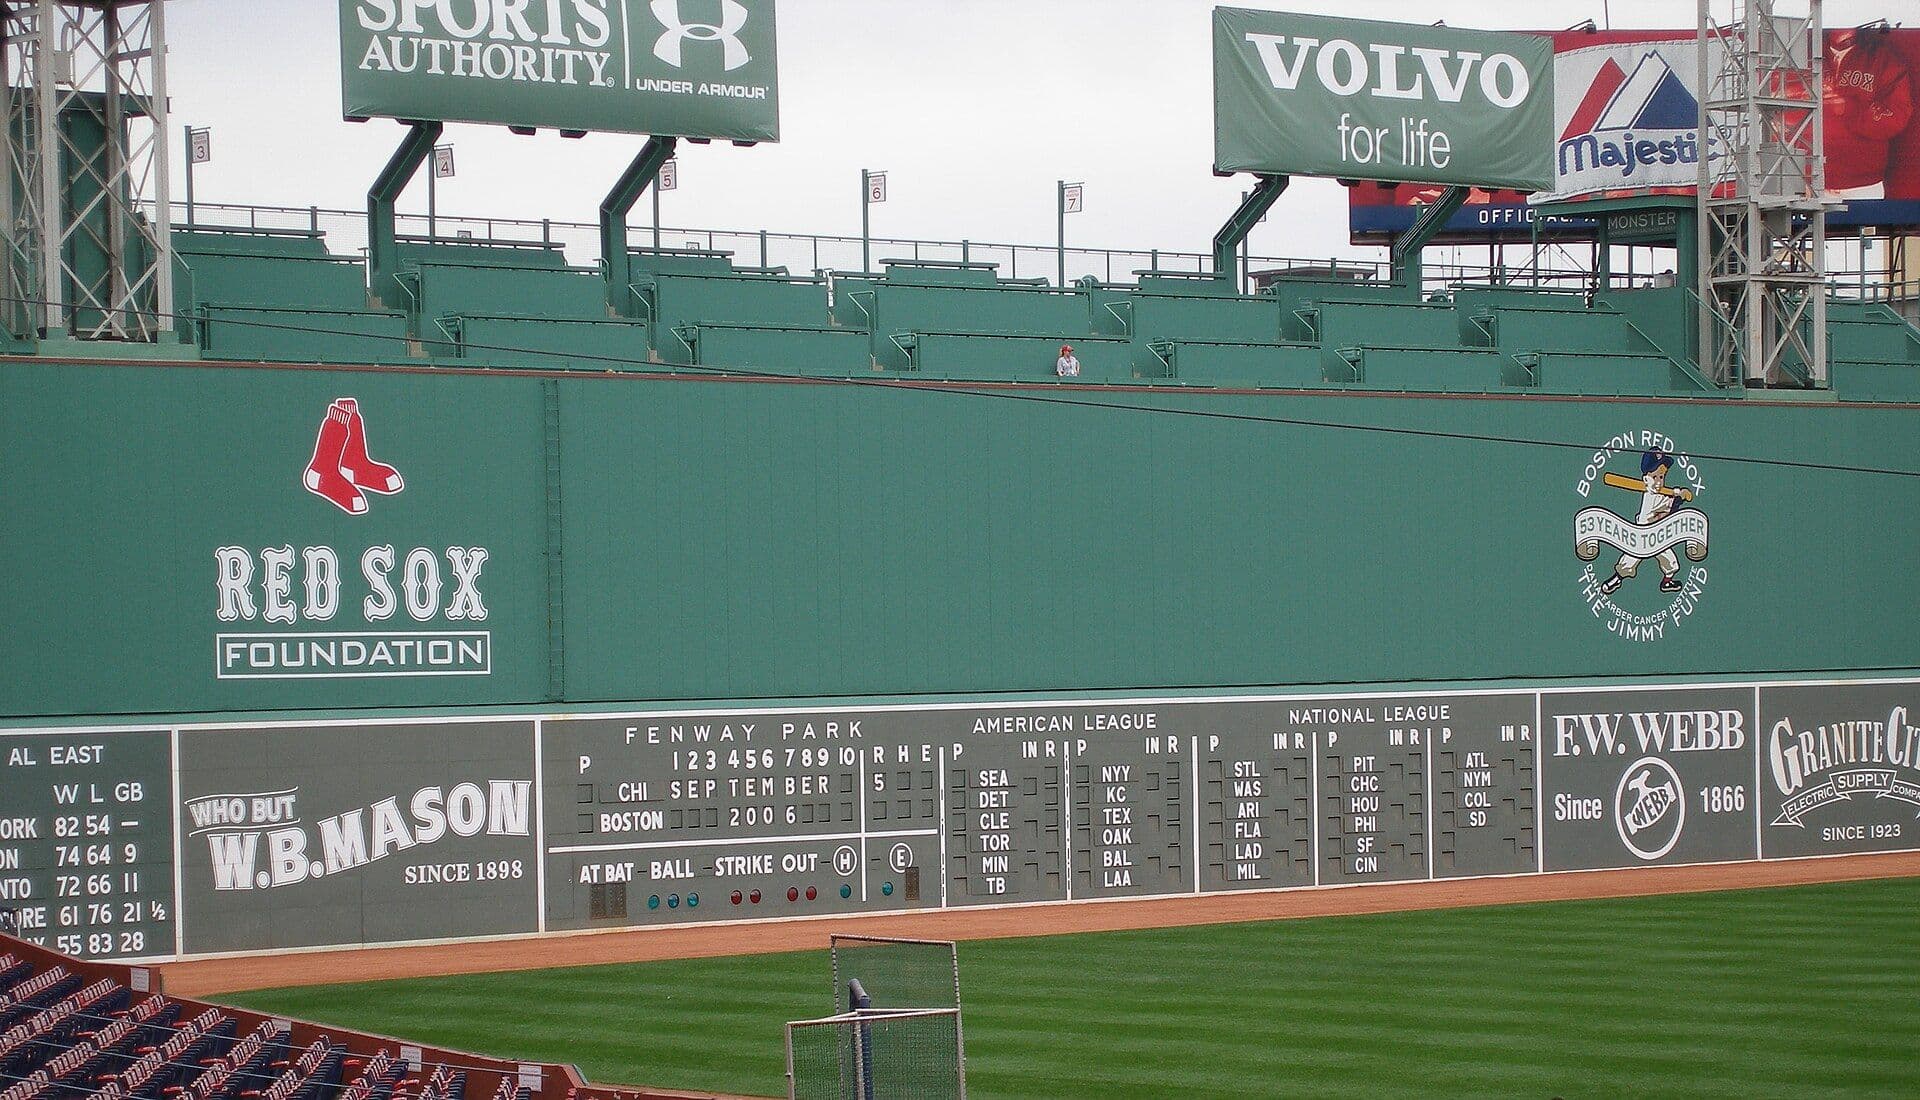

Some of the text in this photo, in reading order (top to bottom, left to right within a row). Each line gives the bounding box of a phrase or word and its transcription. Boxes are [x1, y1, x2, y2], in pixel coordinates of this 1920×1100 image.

[359, 34, 612, 88] AUTHORITY
[1245, 32, 1530, 108] VOLVO
[636, 78, 766, 99] UNDER ARMOUR
[1338, 112, 1450, 169] for life
[197, 146, 205, 159] 3
[441, 161, 449, 173] 4
[664, 175, 671, 187] 5
[872, 187, 881, 199] 6
[1068, 198, 1077, 210] 7
[1608, 211, 1676, 230] MONSTER
[1577, 430, 1706, 498] BOSTON RED SOX
[1579, 516, 1704, 549] 53 YEARS TOGETHER
[215, 544, 489, 625] RED SOX
[1578, 567, 1708, 642] THE JIMMY FUND
[1634, 610, 1668, 625] CANCER
[1669, 566, 1697, 613] INSTITUTE
[226, 640, 482, 668] FOUNDATION
[972, 713, 1157, 734] AMERICAN LEAGUE
[1289, 705, 1450, 724] NATIONAL LEAGUE
[625, 720, 863, 745] FENWAY PARK
[1328, 728, 1420, 748] P IN R
[1442, 724, 1530, 744] P IN R
[1628, 709, 1745, 753] WEBB
[953, 740, 1056, 760] P IN R
[1077, 736, 1178, 756] P IN R
[1209, 732, 1305, 752] P IN R
[9, 745, 103, 766] AL EAST
[579, 756, 590, 773] P
[872, 745, 884, 763] R
[897, 744, 908, 762] H
[921, 744, 931, 761] E
[1353, 757, 1374, 772] PIT
[1465, 752, 1489, 768] ATL
[1769, 716, 1883, 796] GRANITE
[979, 770, 1008, 787] SEA
[1102, 766, 1130, 782] NYY
[1234, 761, 1260, 777] STL
[617, 783, 648, 801] CHI
[873, 773, 885, 792] 5
[1351, 776, 1379, 793] CHC
[1464, 771, 1491, 787] NYM
[1837, 773, 1890, 789] SUPPLY
[53, 783, 144, 804] W L GB
[1106, 787, 1127, 803] KC
[1234, 781, 1261, 797] WAS
[979, 791, 1009, 808] DET
[1351, 797, 1379, 812] HOU
[1465, 792, 1490, 807] COL
[1554, 786, 1745, 821] Since 1866
[1632, 789, 1670, 828] WEBB
[1787, 786, 1833, 815] ELECTRIC
[190, 795, 296, 826] WHO BUT
[1103, 808, 1132, 824] TEX
[1237, 802, 1260, 818] ARI
[1470, 811, 1486, 827] SD
[54, 817, 79, 837] 82
[86, 815, 110, 835] 54
[601, 811, 663, 833] BOSTON
[980, 813, 1010, 830] CLE
[1235, 821, 1261, 838] FLA
[1355, 816, 1376, 832] PHI
[1102, 829, 1132, 845] OAK
[1822, 824, 1901, 841] SINCE 1923
[980, 834, 1010, 851] TOR
[1235, 842, 1262, 859] LAD
[1357, 837, 1373, 853] SF
[56, 846, 80, 867] 74
[86, 844, 111, 866] 64
[125, 843, 137, 864] 9
[982, 856, 1009, 873] MIN
[1103, 851, 1132, 867] BAL
[405, 860, 523, 884] SINCE 1898
[579, 852, 818, 883] AT BAT BALL STRIKE OUT
[1237, 863, 1261, 879] MIL
[1355, 857, 1377, 873] CIN
[56, 876, 80, 897] 72
[87, 874, 111, 895] 66
[986, 878, 1006, 894] TB
[1104, 870, 1132, 887] LAA
[60, 906, 78, 926] 61
[88, 904, 112, 925] 76
[124, 902, 141, 922] 21
[57, 935, 82, 955] 55
[89, 932, 113, 954] 83
[121, 931, 144, 952] 28
